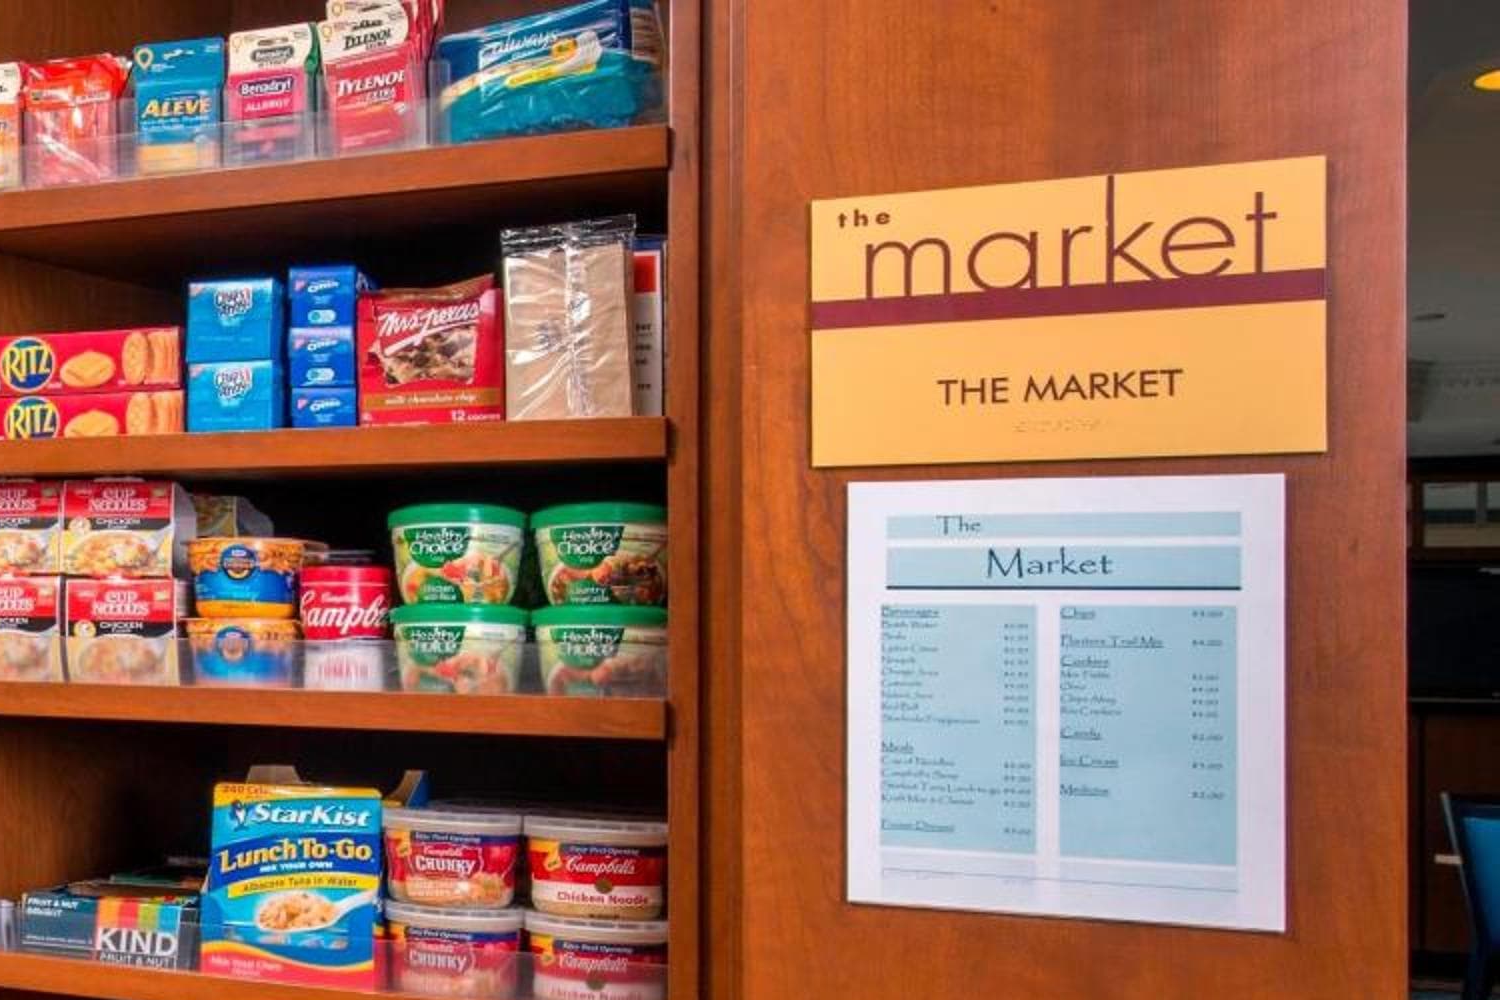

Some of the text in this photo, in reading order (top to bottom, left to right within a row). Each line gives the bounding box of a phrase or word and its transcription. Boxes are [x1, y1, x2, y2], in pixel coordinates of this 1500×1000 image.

[240, 76, 293, 96] Benadryl
[337, 70, 405, 96] TYLENOL
[142, 97, 211, 119] ALEVE
[837, 208, 891, 229] the
[864, 174, 1278, 300] market
[3, 345, 51, 382] RITZ
[937, 368, 1184, 406] THE MARKET
[8, 404, 54, 439] RITZ
[936, 514, 982, 536] The
[409, 540, 464, 555] Choice
[557, 540, 615, 555] Choice
[986, 546, 1114, 580] Market
[251, 802, 372, 827] StarKist
[220, 838, 298, 873] Lunch
[415, 855, 477, 875] CHUNKY
[557, 890, 606, 905] Chicken
[97, 927, 178, 958] KIND
